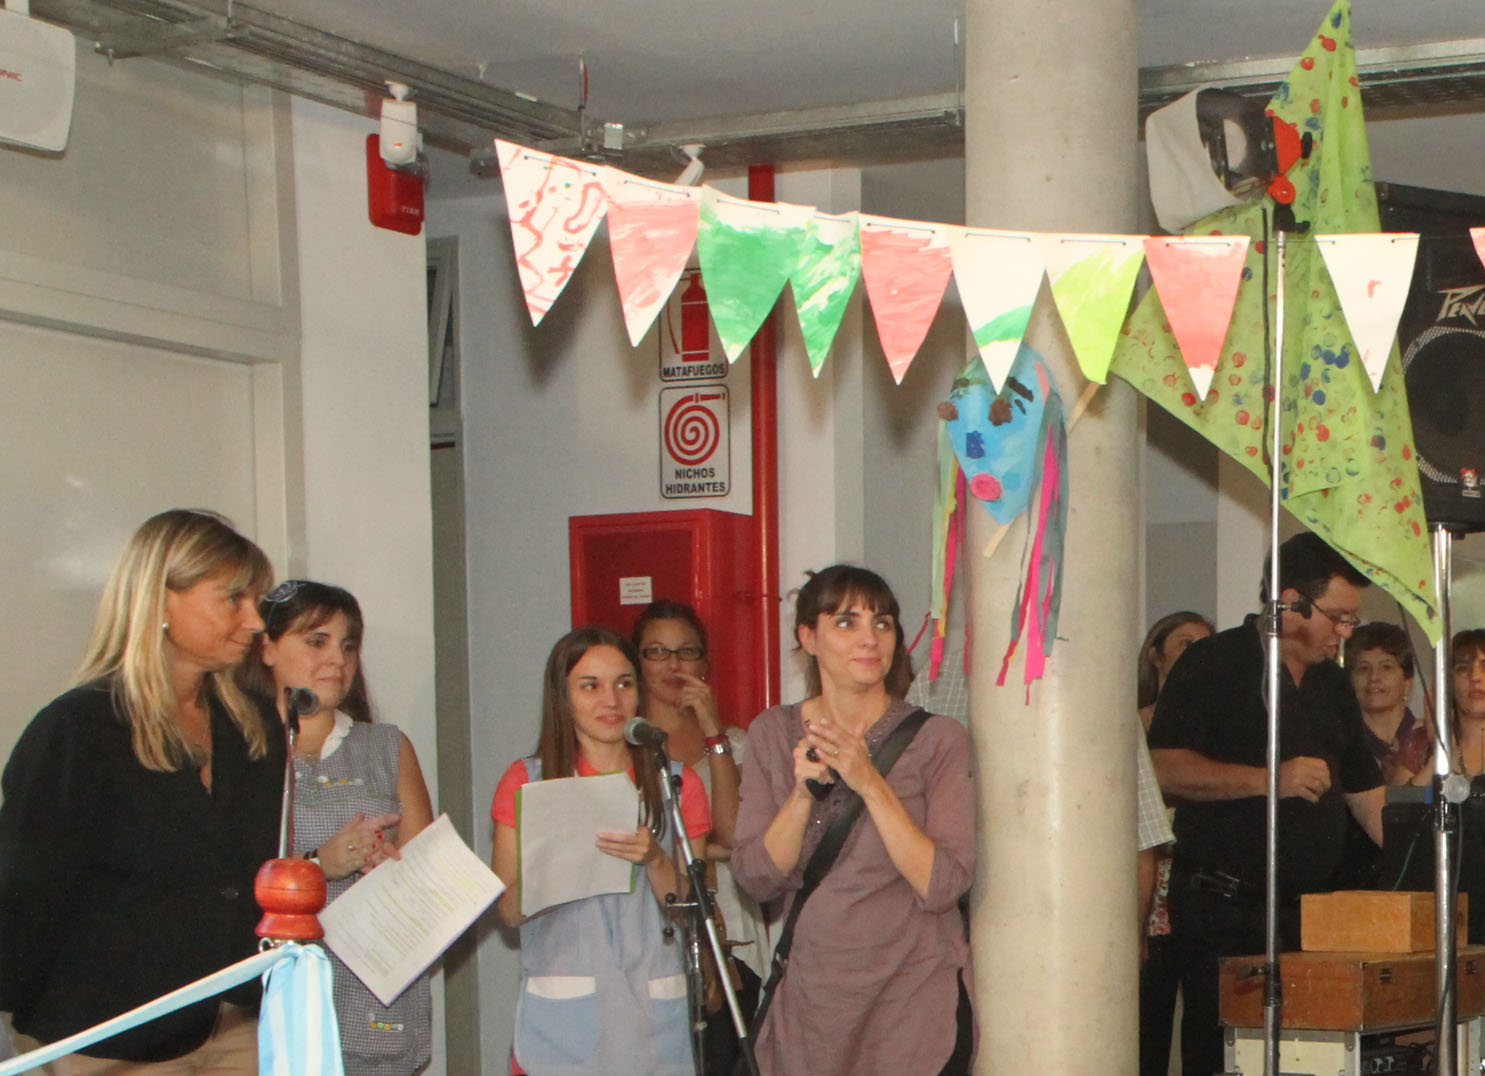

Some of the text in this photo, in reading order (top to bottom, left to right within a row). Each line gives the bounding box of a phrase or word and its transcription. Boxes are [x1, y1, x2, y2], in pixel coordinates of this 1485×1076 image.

[663, 363, 725, 377] MATAFUEGOS
[674, 467, 715, 479] NICHOS
[665, 482, 726, 494] HIDRANTES
